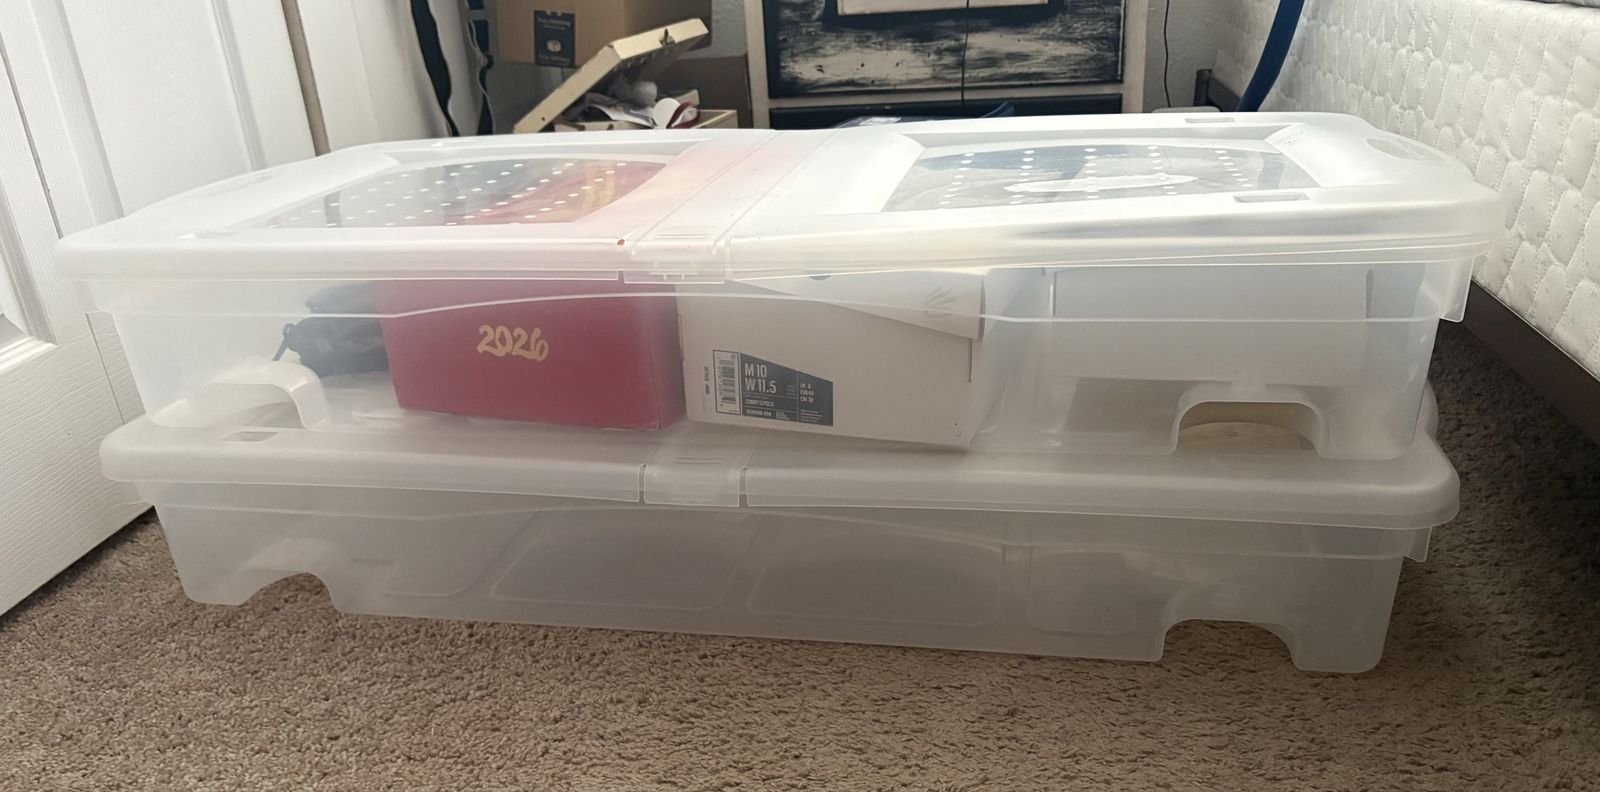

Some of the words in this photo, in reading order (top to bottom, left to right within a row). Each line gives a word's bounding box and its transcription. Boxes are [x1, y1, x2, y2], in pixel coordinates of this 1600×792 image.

[476, 324, 549, 361] 2026
[744, 363, 754, 377] M
[756, 363, 767, 378] 10
[744, 377, 755, 391] W
[757, 379, 777, 394] 11.5
